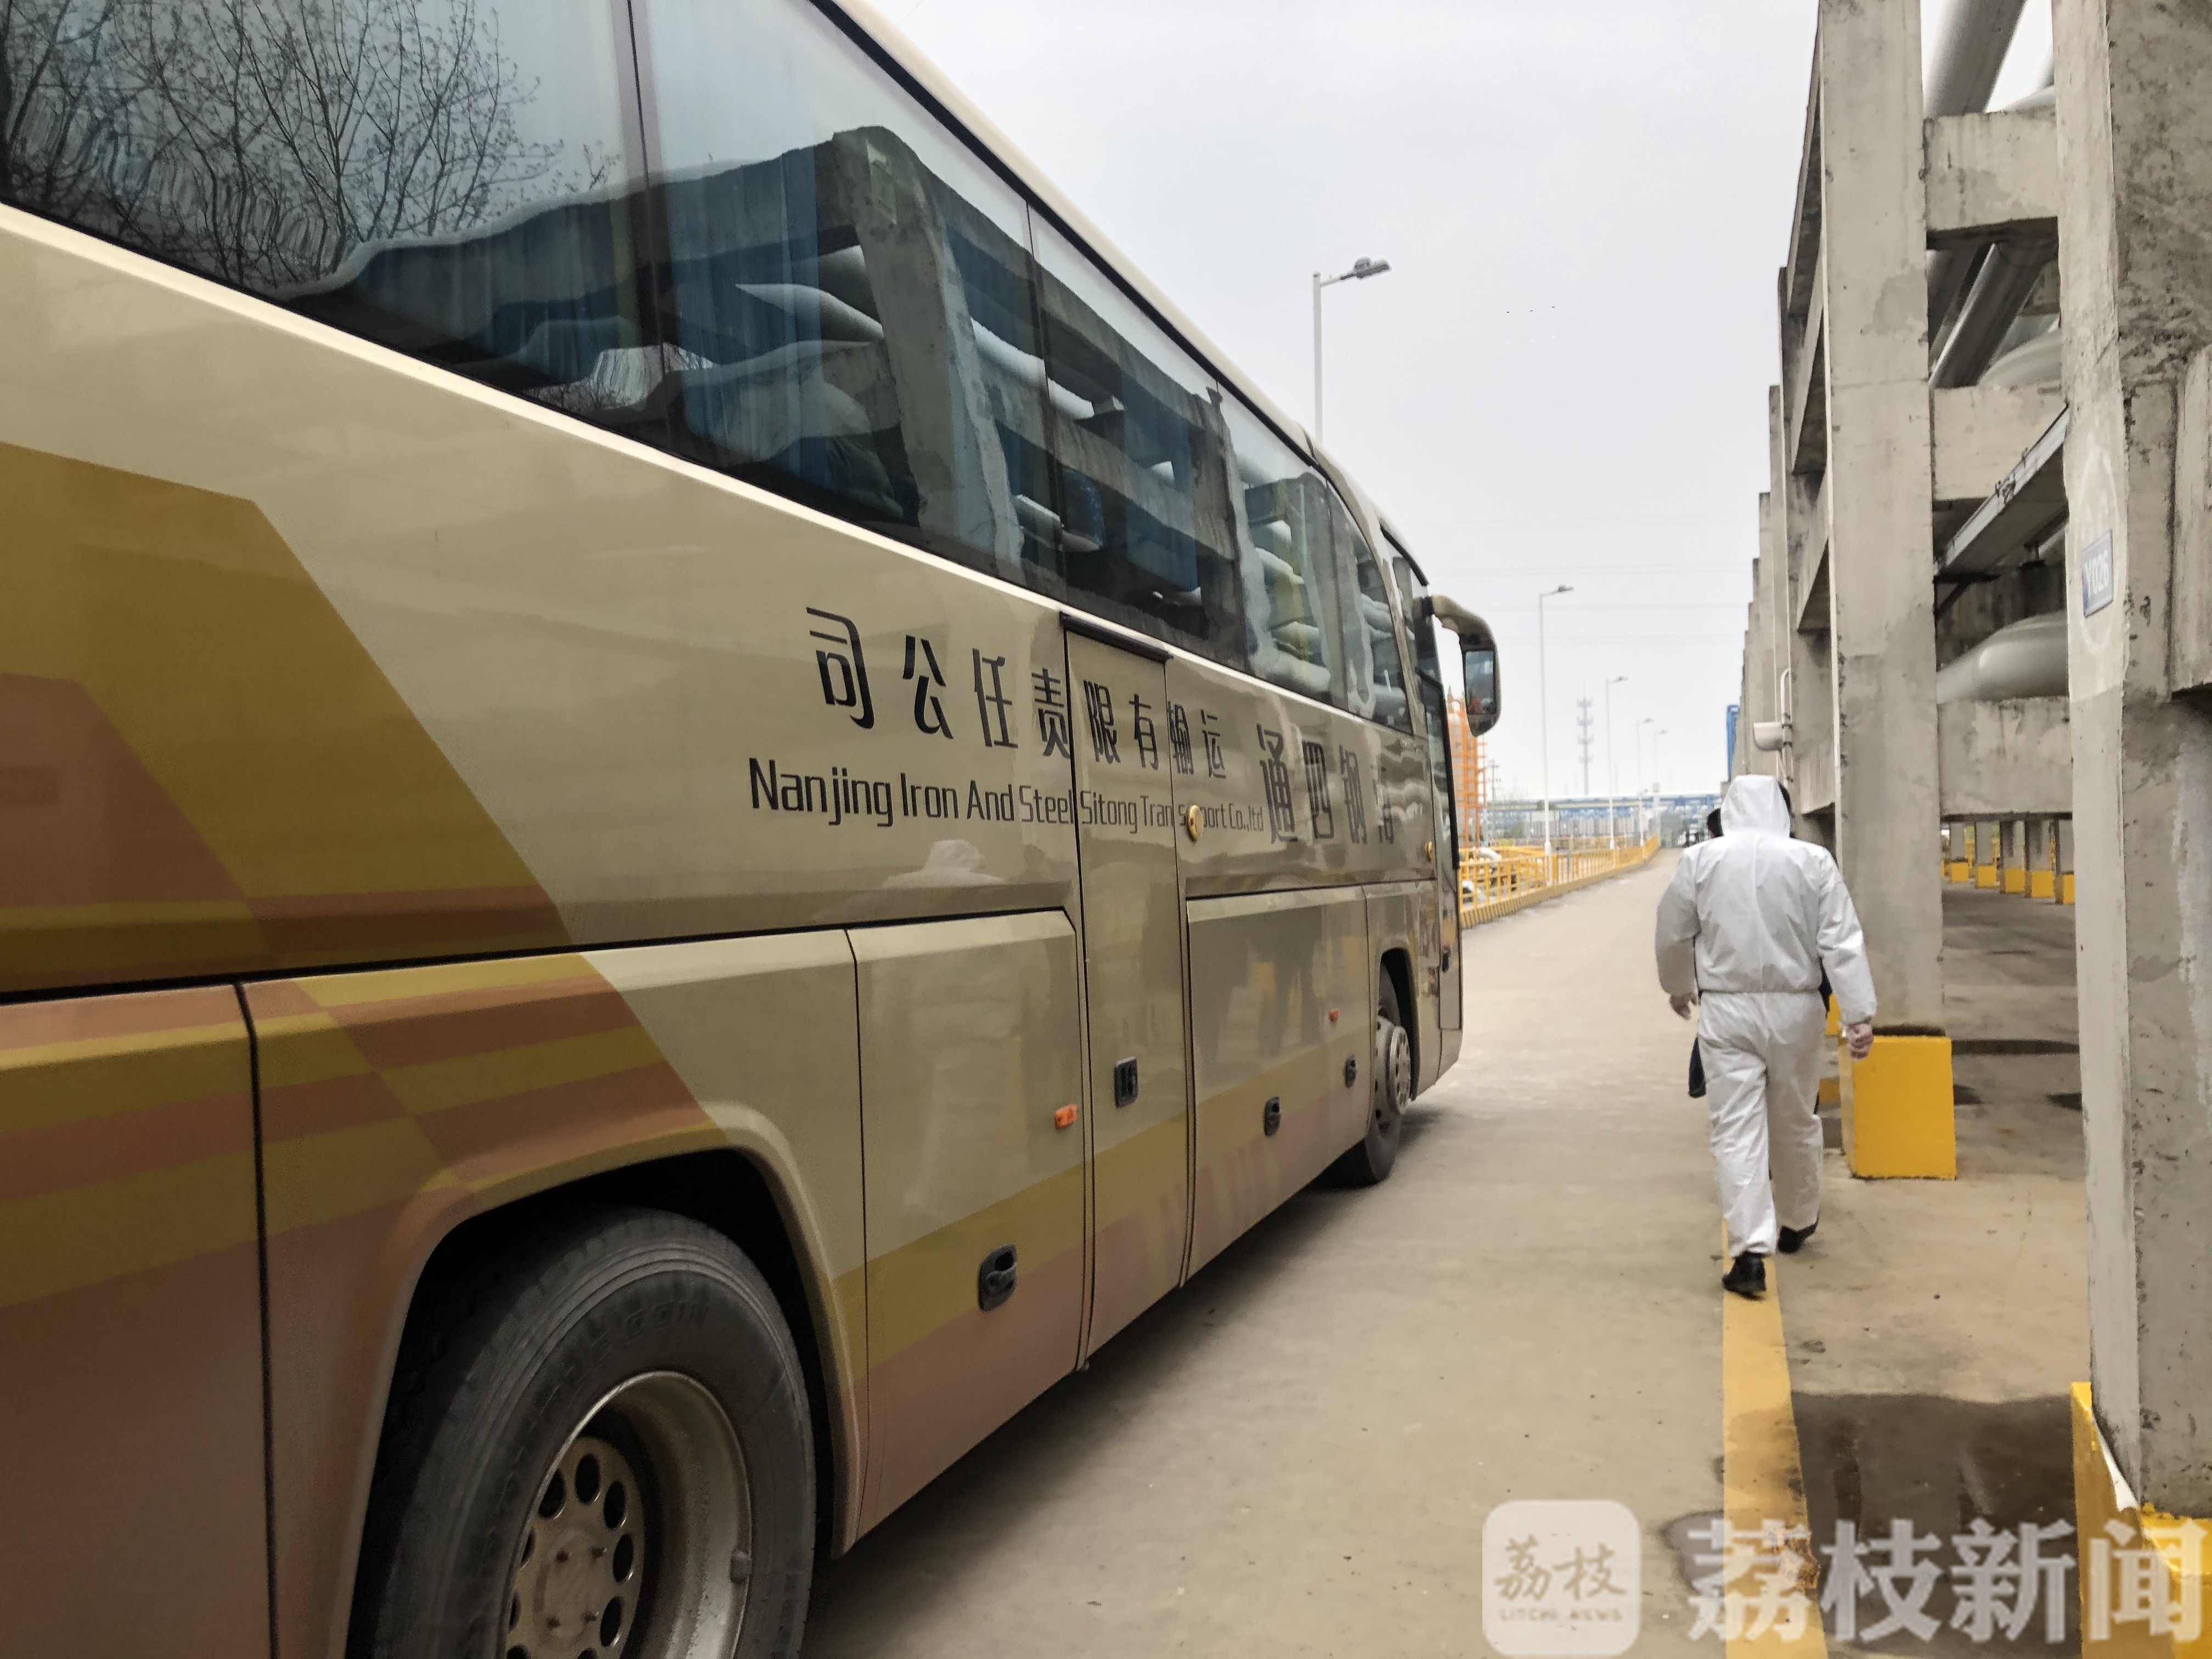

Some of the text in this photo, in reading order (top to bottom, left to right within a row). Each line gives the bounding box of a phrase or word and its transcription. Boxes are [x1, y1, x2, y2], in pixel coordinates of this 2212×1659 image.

[748, 757, 894, 827] Nanjing
[900, 772, 959, 820] Iron
[967, 779, 1015, 821] And
[1019, 785, 1074, 824] Steel
[1080, 790, 1138, 834] Sitong
